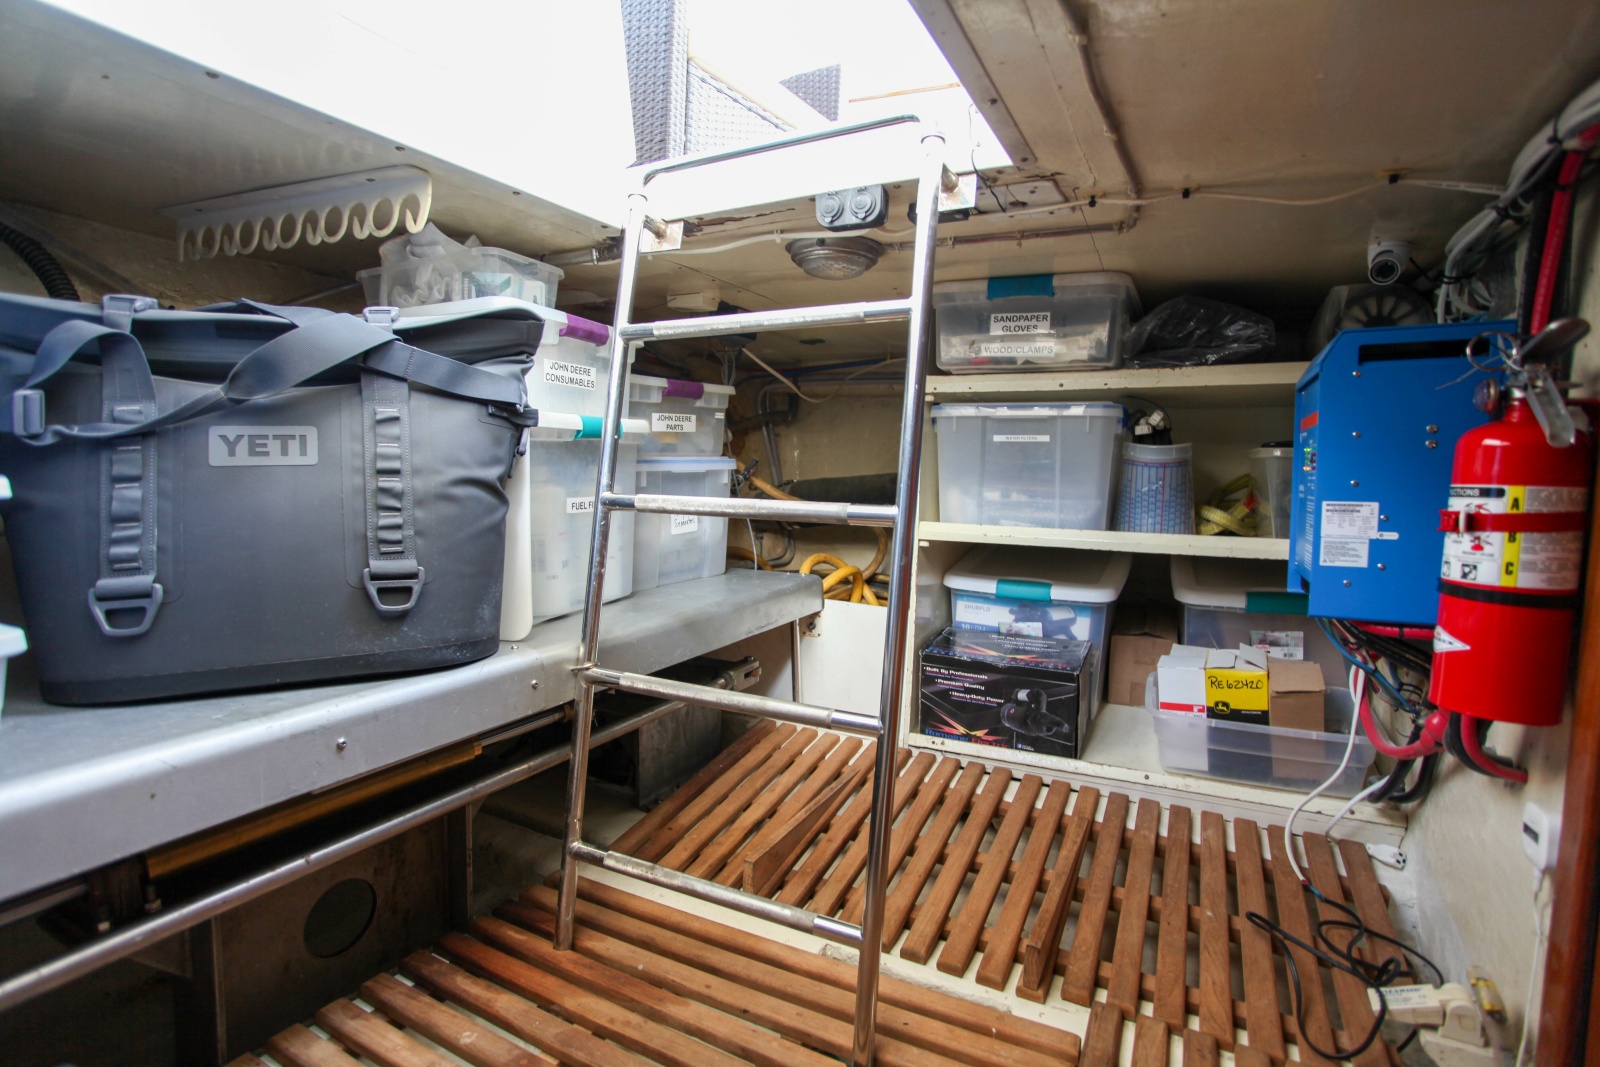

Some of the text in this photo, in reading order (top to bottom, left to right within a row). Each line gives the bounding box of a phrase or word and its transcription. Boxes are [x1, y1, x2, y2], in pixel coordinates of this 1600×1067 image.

[993, 314, 1049, 323] SANDPAPER
[1001, 324, 1038, 333] GLOVES
[984, 346, 1053, 354] WOOD/CLAMPS
[549, 361, 592, 377] JOHN DEERE
[545, 372, 595, 389] CONSUMABLES
[656, 414, 692, 423] JOHN DEERE
[666, 423, 684, 431] PARTS
[217, 434, 308, 457] YETI
[571, 501, 588, 511] FUEL
[1510, 497, 1520, 511] A
[1507, 531, 1517, 543] B
[1504, 562, 1515, 576] C
[963, 603, 991, 613] SHURFLO
[926, 666, 940, 674] Built
[940, 667, 949, 675] By
[949, 669, 988, 680] Professionals
[937, 678, 963, 687] Premium
[963, 682, 985, 690] Quality
[952, 691, 986, 701] Heavy-Duty
[986, 696, 1004, 704] Power
[925, 728, 969, 742] Romaine
